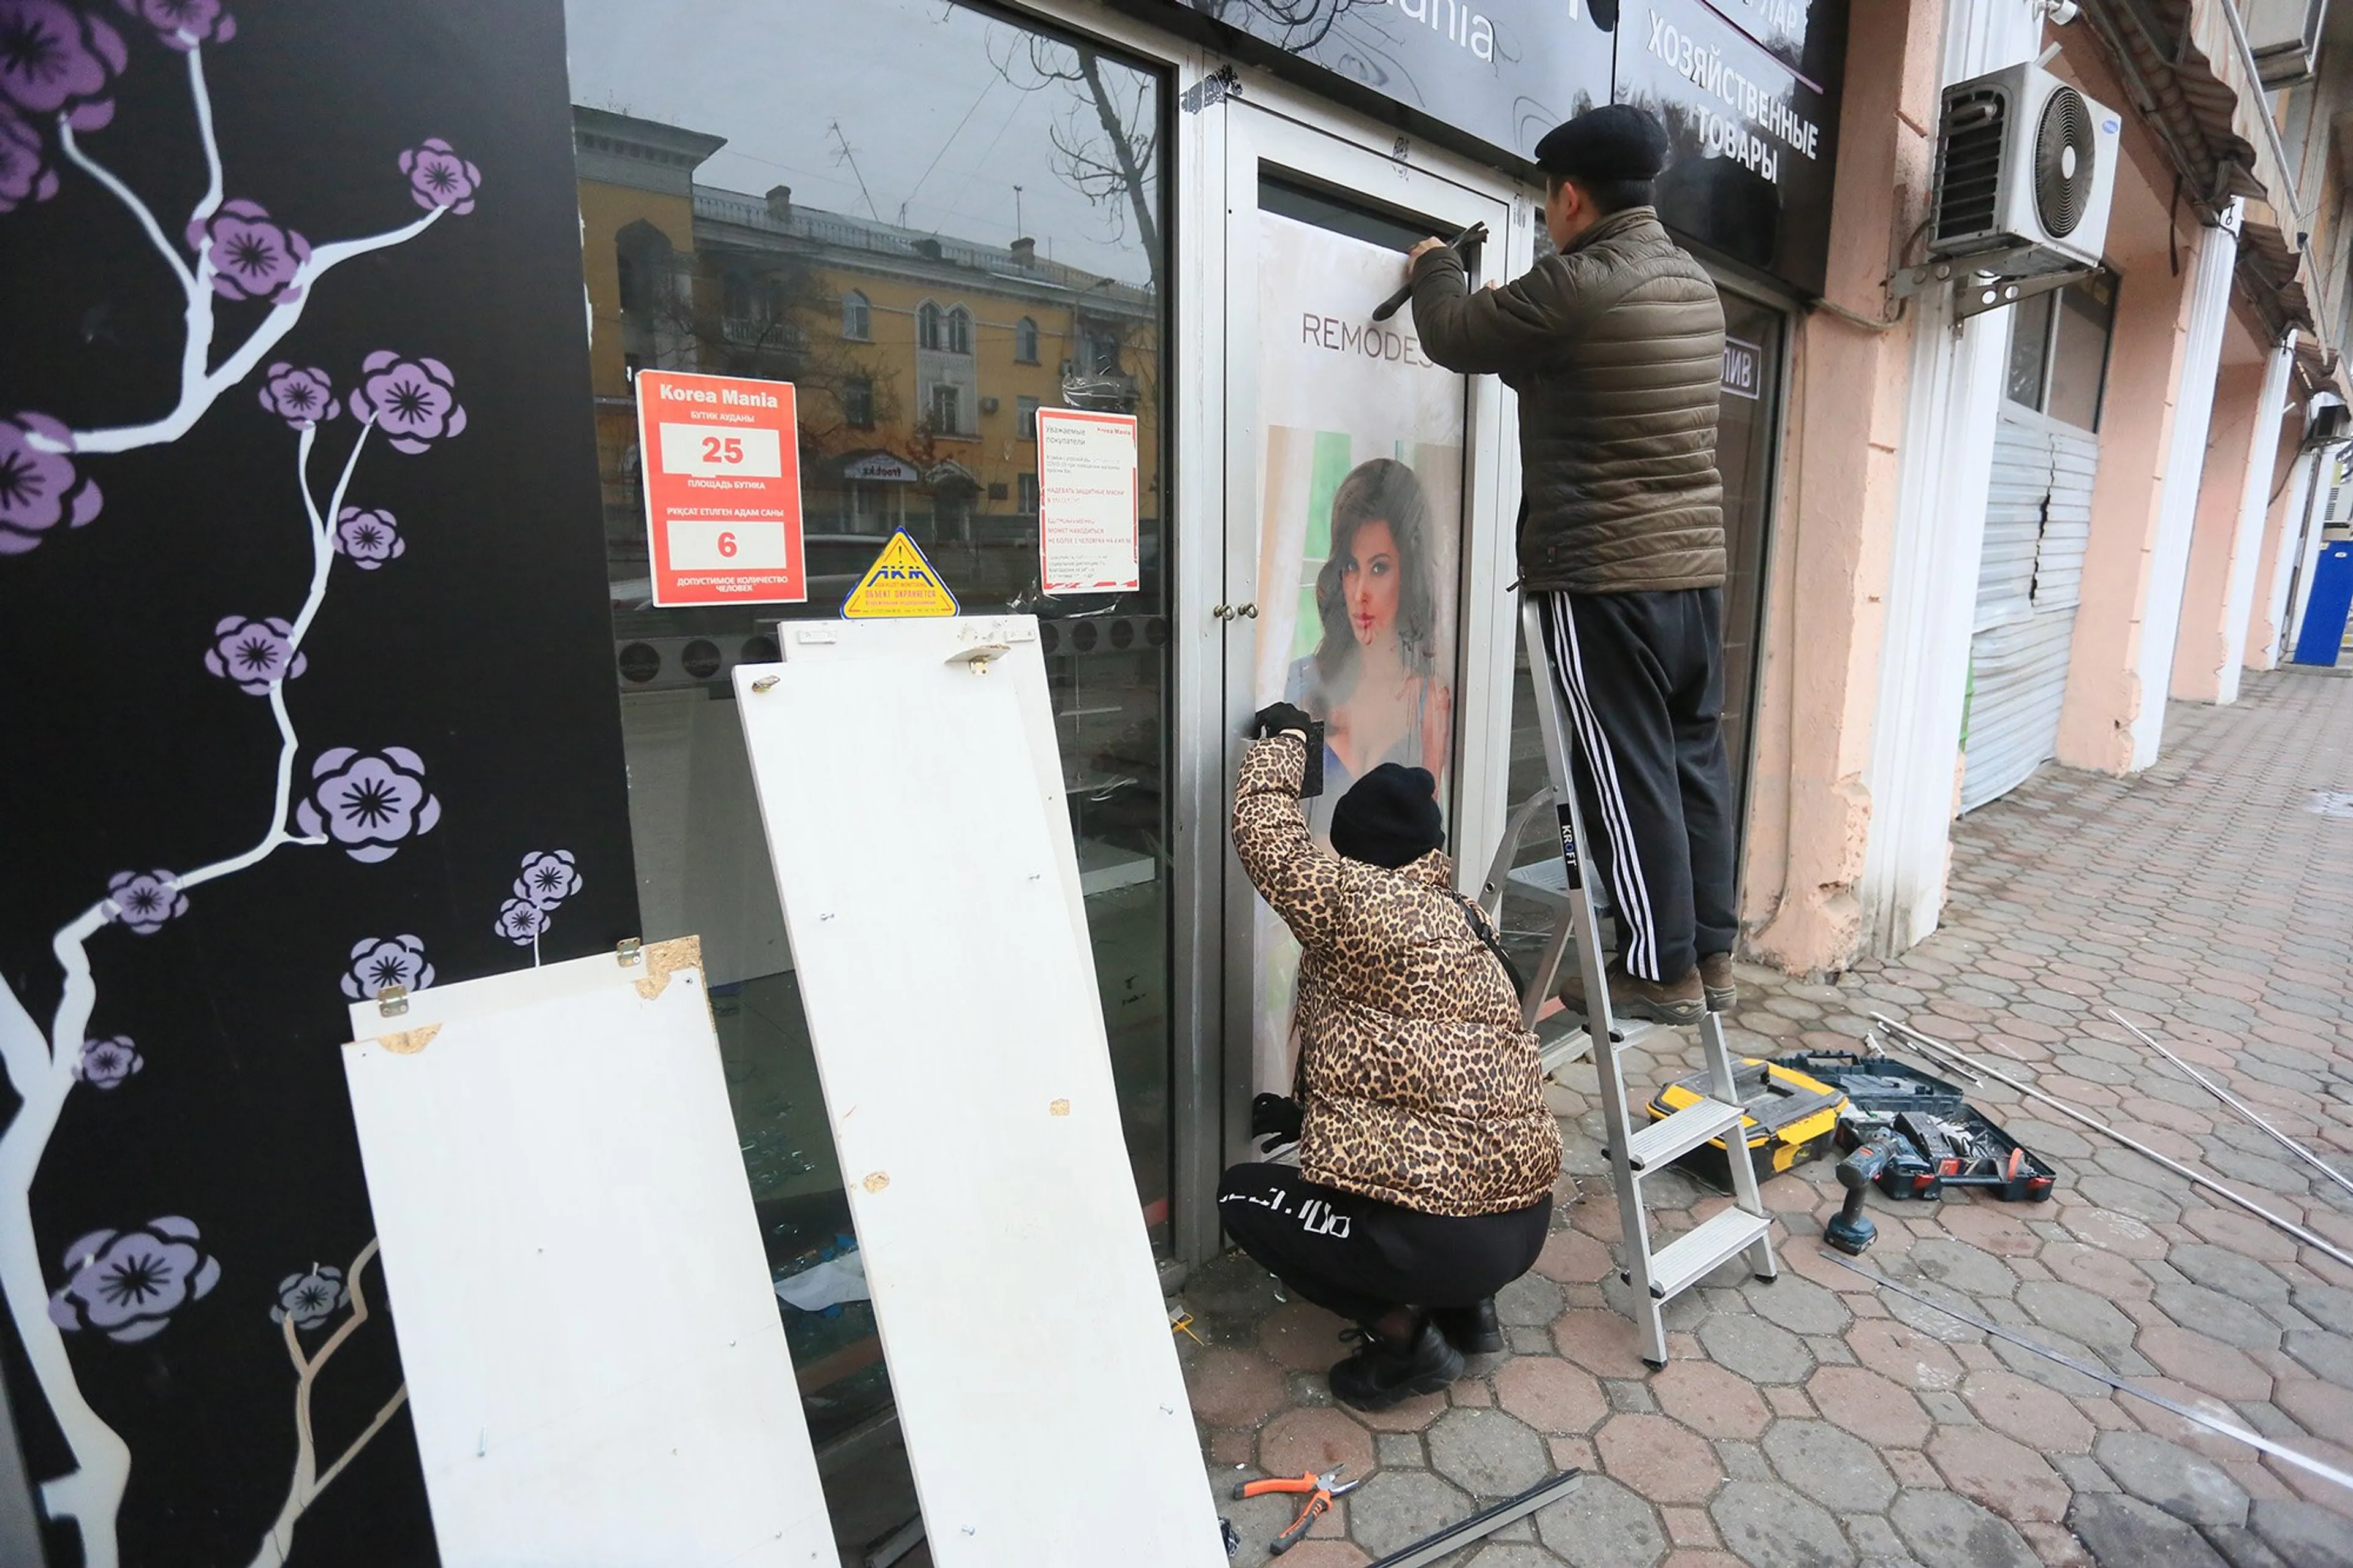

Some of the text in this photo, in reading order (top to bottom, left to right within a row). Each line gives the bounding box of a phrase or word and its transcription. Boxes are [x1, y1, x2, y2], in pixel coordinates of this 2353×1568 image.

[1647, 9, 1819, 161] ХОЗЯЙСТВЕННЫЕ
[1694, 103, 1778, 184] ТОВАРЫ
[1302, 312, 1434, 369] REMODE
[659, 384, 778, 409] Korea Mania
[691, 411, 754, 423] БУТИК АУДАНЫ
[702, 436, 743, 464] 25
[688, 480, 765, 490] ПЛОЩАДЬ БУТИКА
[734, 509, 759, 518] АДАМ
[760, 509, 784, 517] САНЫ
[718, 532, 737, 558] 6
[677, 576, 788, 586] ДОПУСТИМОЕ КОЛИЧЕСТВО
[1562, 825, 1577, 866] KROFT
